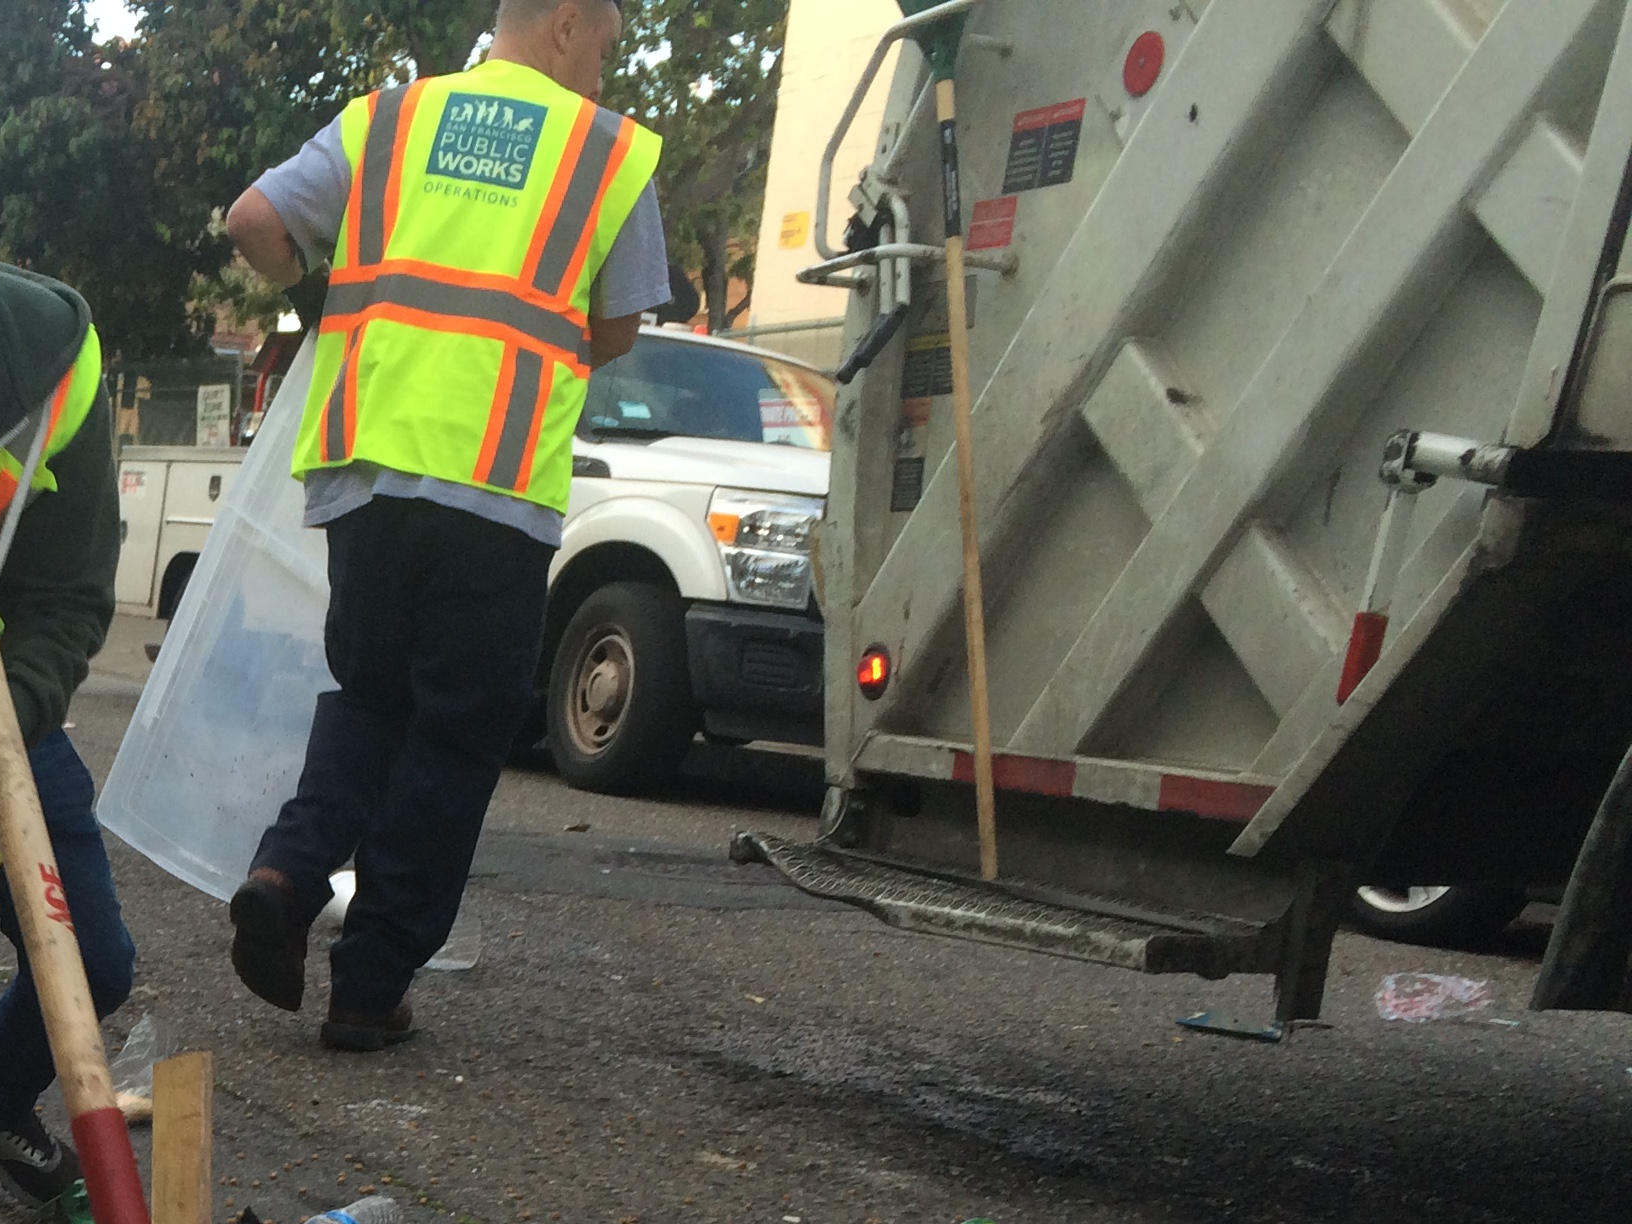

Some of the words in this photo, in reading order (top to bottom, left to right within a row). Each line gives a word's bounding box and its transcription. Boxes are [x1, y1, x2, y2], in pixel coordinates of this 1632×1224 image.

[440, 131, 529, 162] PUBLIC
[445, 121, 467, 132] SAN
[470, 125, 532, 143] FRANCISCO
[438, 150, 524, 182] WORKS
[424, 181, 518, 208] OPERATIONS
